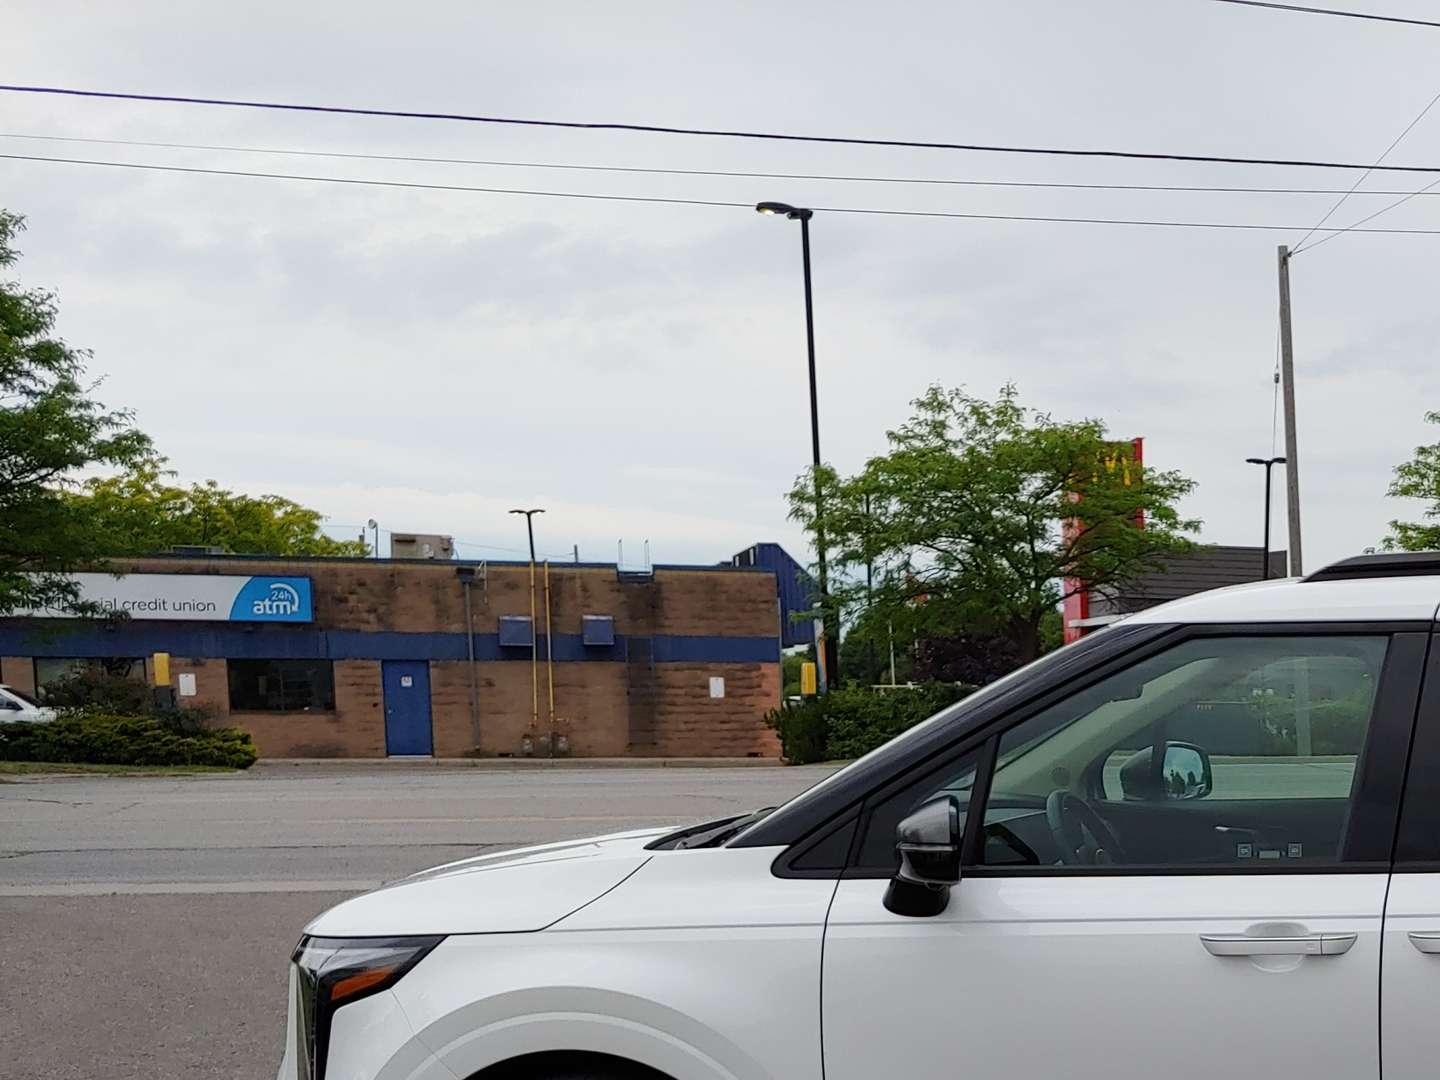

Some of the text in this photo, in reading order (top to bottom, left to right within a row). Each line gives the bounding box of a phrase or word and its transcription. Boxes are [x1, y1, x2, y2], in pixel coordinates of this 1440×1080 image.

[271, 590, 292, 601] 24h
[122, 598, 169, 612] credit
[172, 598, 216, 612] union
[253, 598, 291, 615] atm
